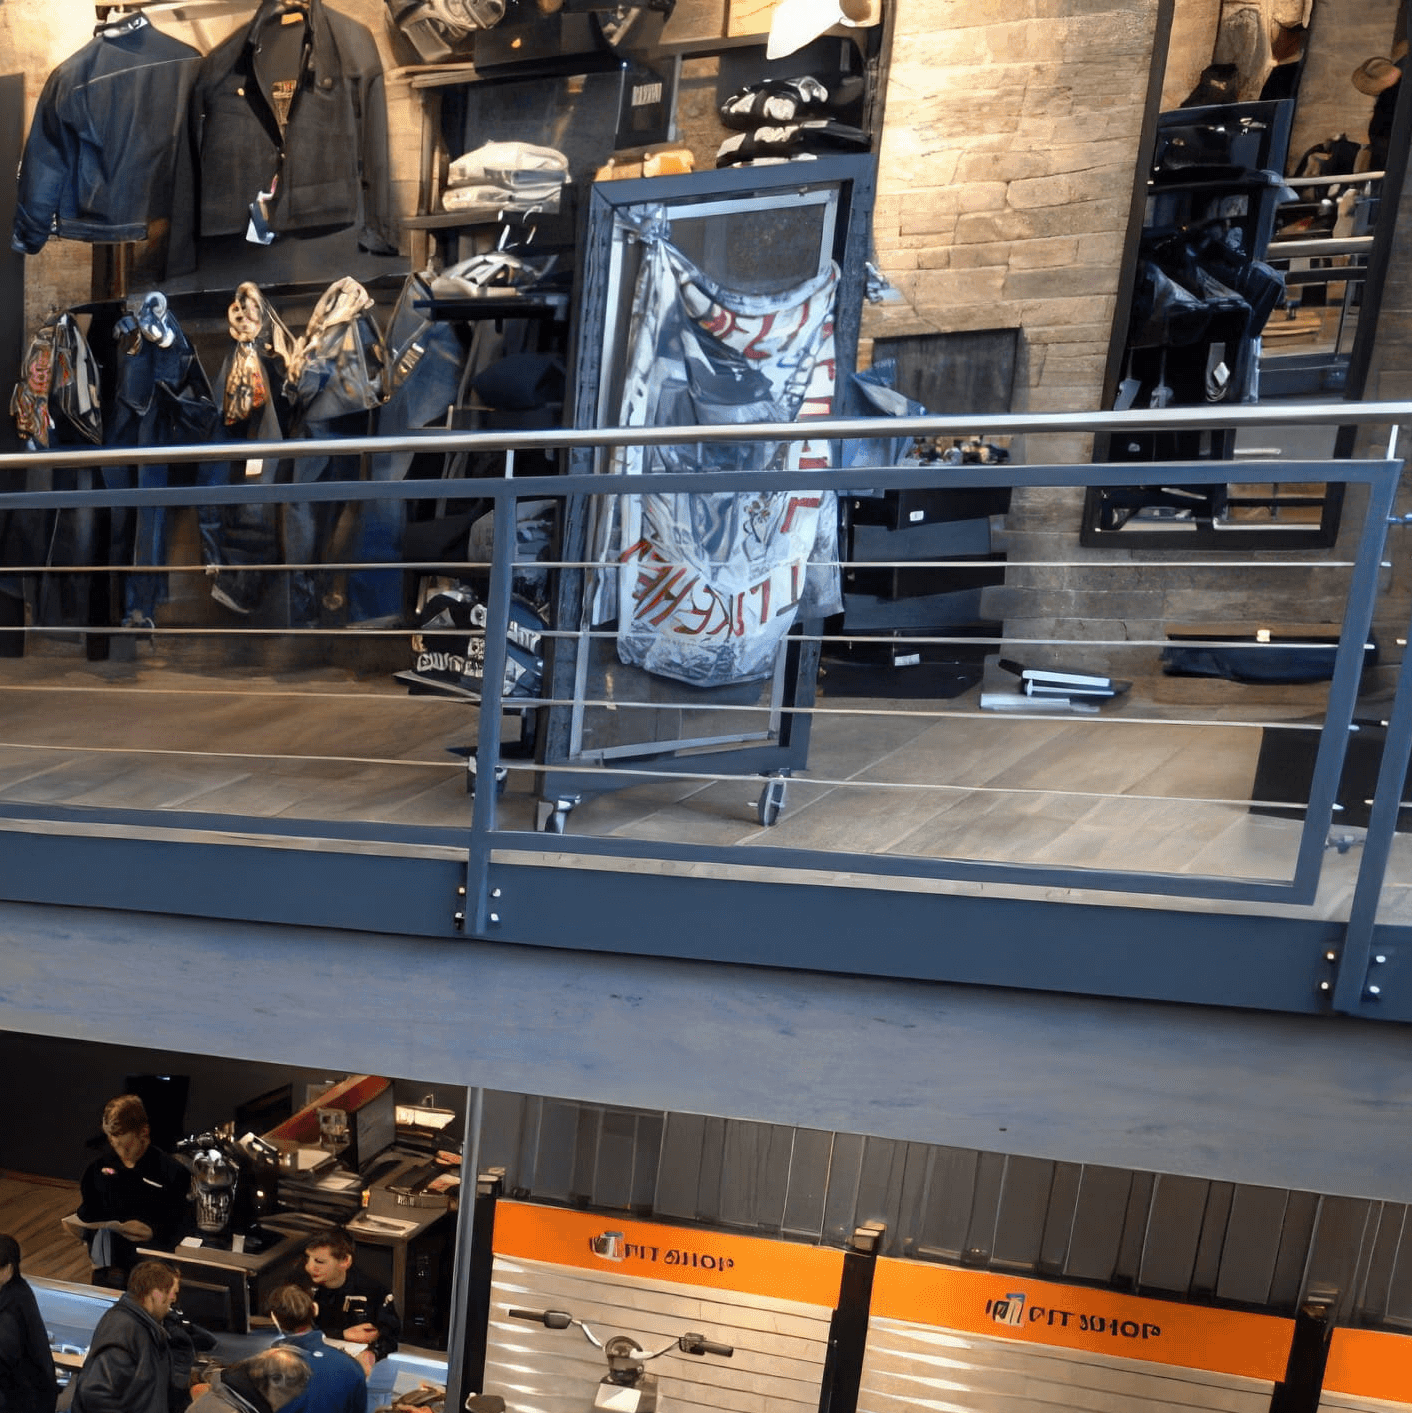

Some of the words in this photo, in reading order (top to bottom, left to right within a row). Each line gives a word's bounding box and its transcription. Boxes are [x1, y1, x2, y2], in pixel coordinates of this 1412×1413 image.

[625, 1242, 659, 1262] PIT
[664, 1249, 734, 1272] SHOP
[1029, 1305, 1074, 1327] PIT
[1079, 1314, 1161, 1340] SHOP
